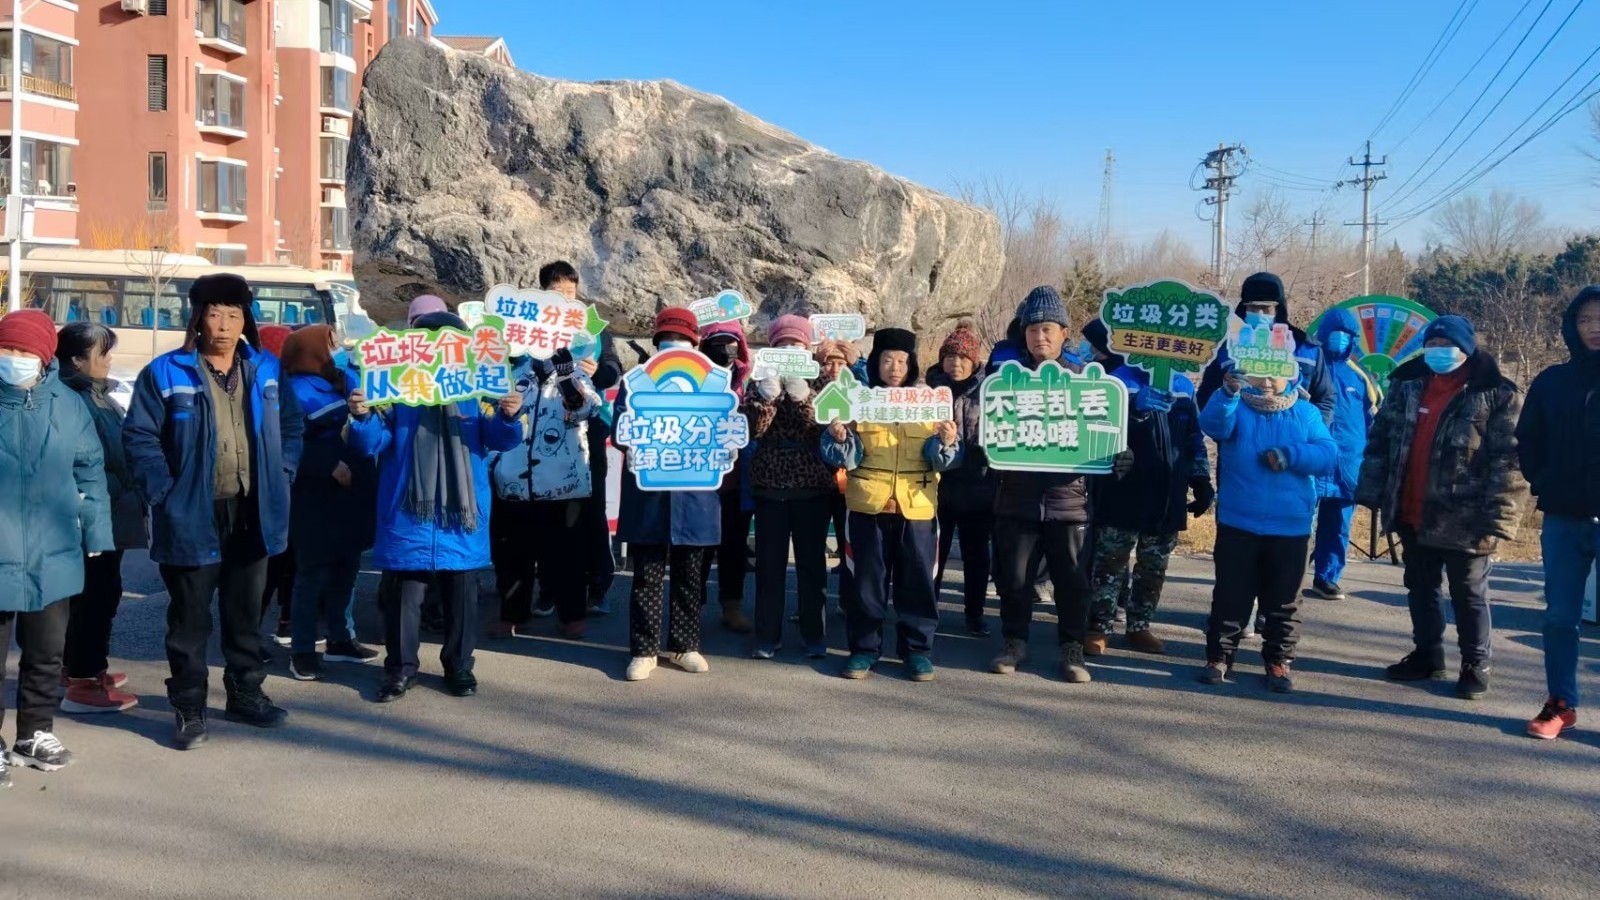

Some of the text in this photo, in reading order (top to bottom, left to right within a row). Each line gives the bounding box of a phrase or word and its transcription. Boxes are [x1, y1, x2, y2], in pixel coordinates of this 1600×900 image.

[495, 297, 584, 330] 垃圾分类
[1112, 303, 1218, 329] 垃圾分类
[361, 328, 506, 365] 垃圾分类
[505, 323, 572, 350] 我先行
[1123, 333, 1205, 356] 生活更美好
[1233, 346, 1287, 361] 垃圾分类
[366, 364, 509, 401] 从我做起
[858, 388, 951, 404] 参与垃圾分类
[858, 405, 951, 421] 共建美好家园
[985, 388, 1109, 420] 不要乱丢
[619, 415, 747, 446] 垃圾分类
[986, 419, 1079, 451] 垃圾哦
[634, 447, 731, 471] 绿色环保
